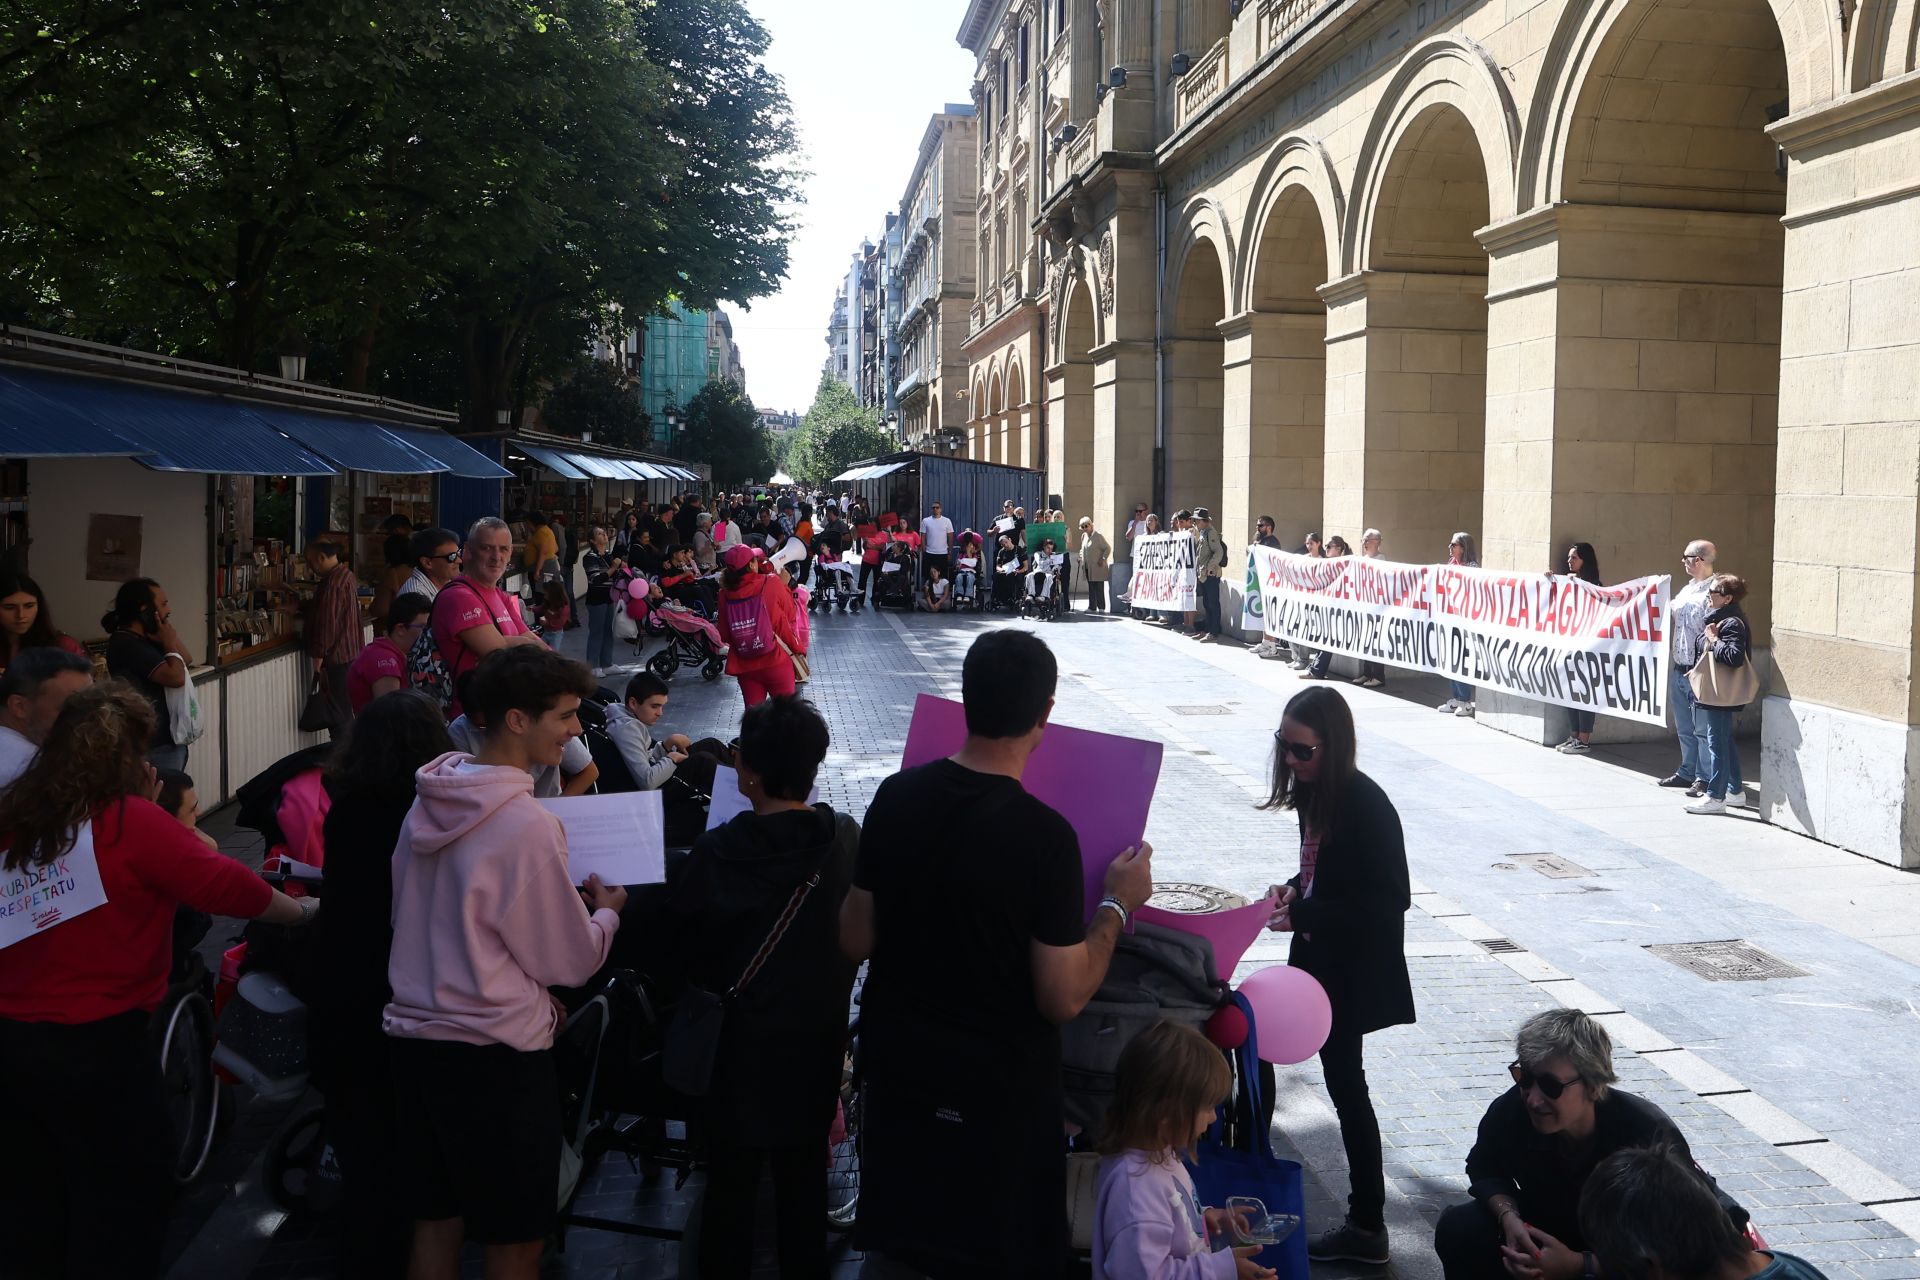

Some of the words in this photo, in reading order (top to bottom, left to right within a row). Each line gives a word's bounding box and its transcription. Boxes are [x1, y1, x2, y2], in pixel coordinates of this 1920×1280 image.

[1435, 564, 1529, 630] HEZKUNTZA
[1265, 595, 1278, 632] NO
[1278, 598, 1288, 635] A
[1286, 600, 1300, 638] LA
[1303, 603, 1364, 654] REDUCCION
[1364, 613, 1386, 657] DEL
[1387, 616, 1447, 670] SERVICIO
[1450, 626, 1470, 677] DE
[1471, 630, 1565, 700] EDUCACION
[1563, 649, 1662, 717] ESPECIAL
